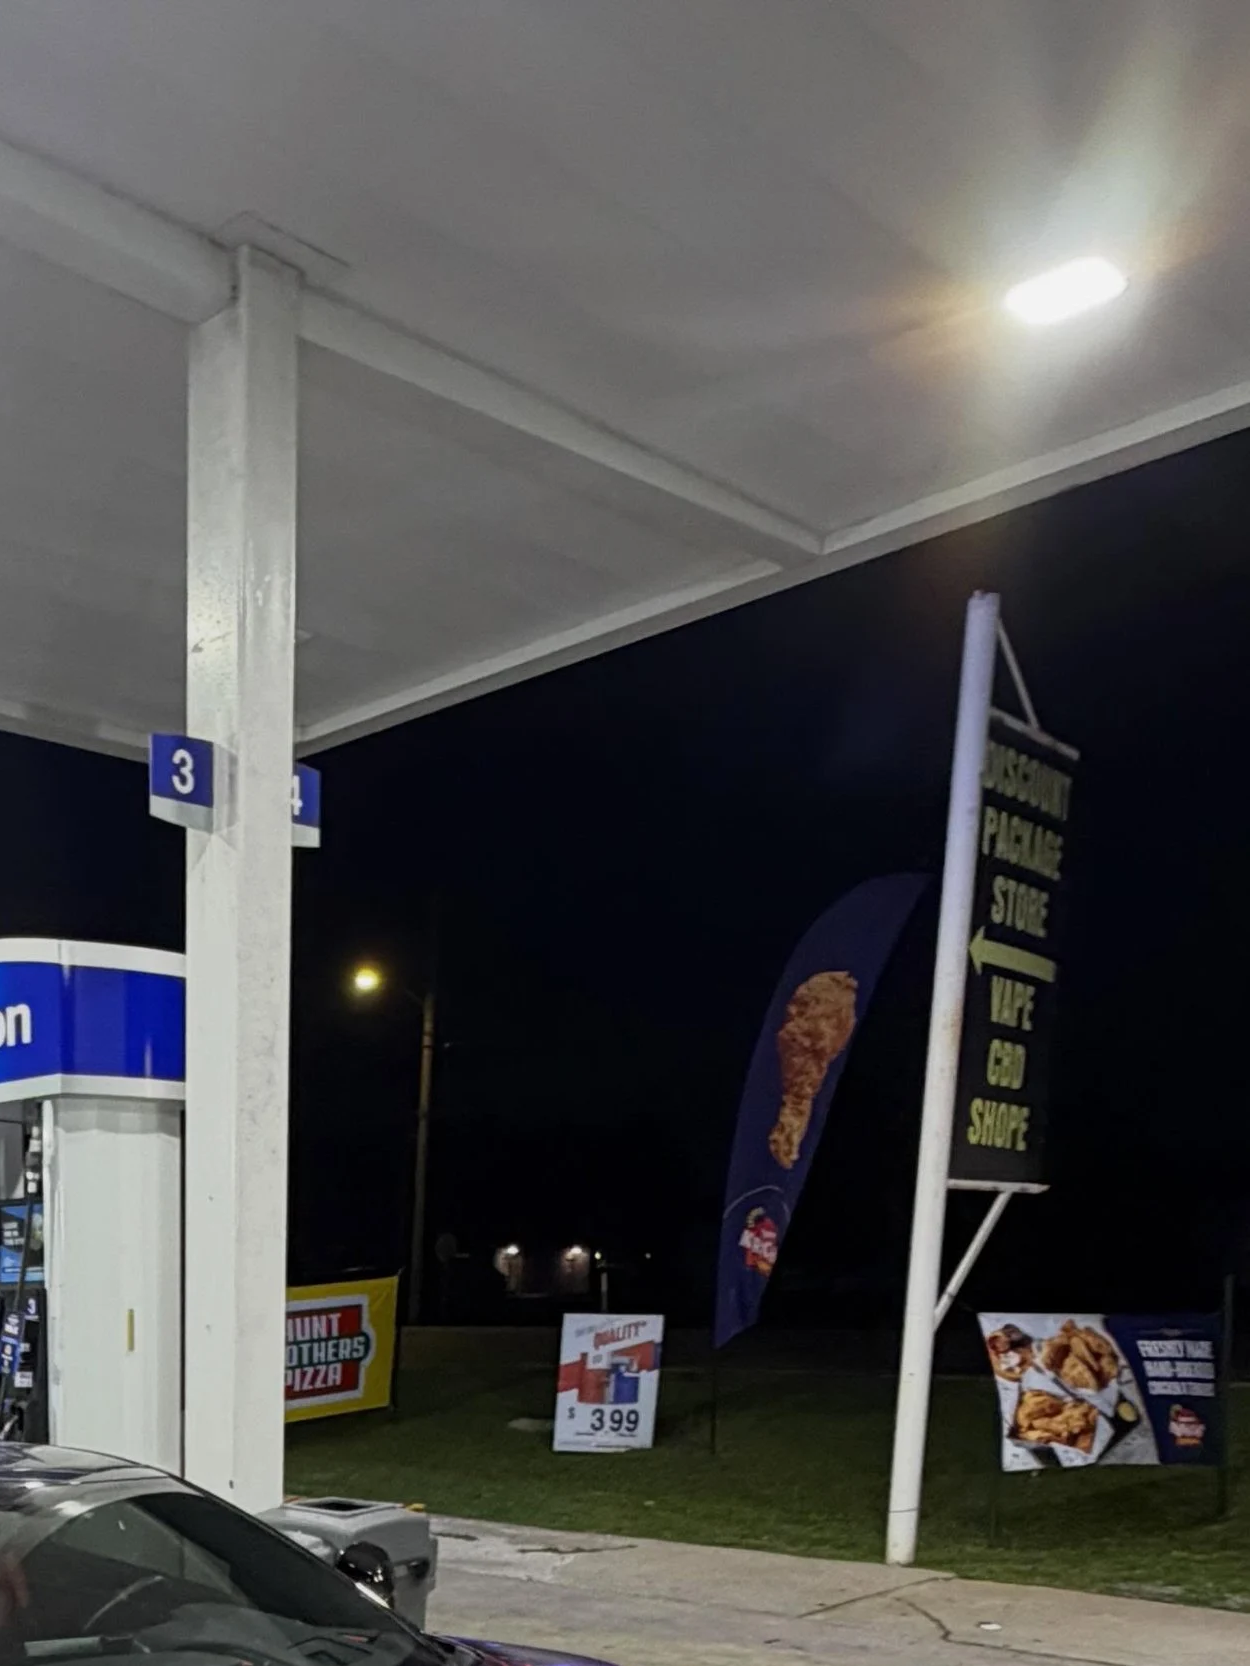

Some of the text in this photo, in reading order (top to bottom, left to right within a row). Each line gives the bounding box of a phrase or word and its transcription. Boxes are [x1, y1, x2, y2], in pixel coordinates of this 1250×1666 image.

[172, 749, 195, 794] 3
[982, 805, 1063, 881] PACKAGE
[991, 875, 1049, 937] STORE
[990, 975, 1036, 1031] VAPE
[987, 1038, 1026, 1090] CBD
[967, 1098, 1030, 1151] SHOPE
[286, 1335, 366, 1367] OTHERS
